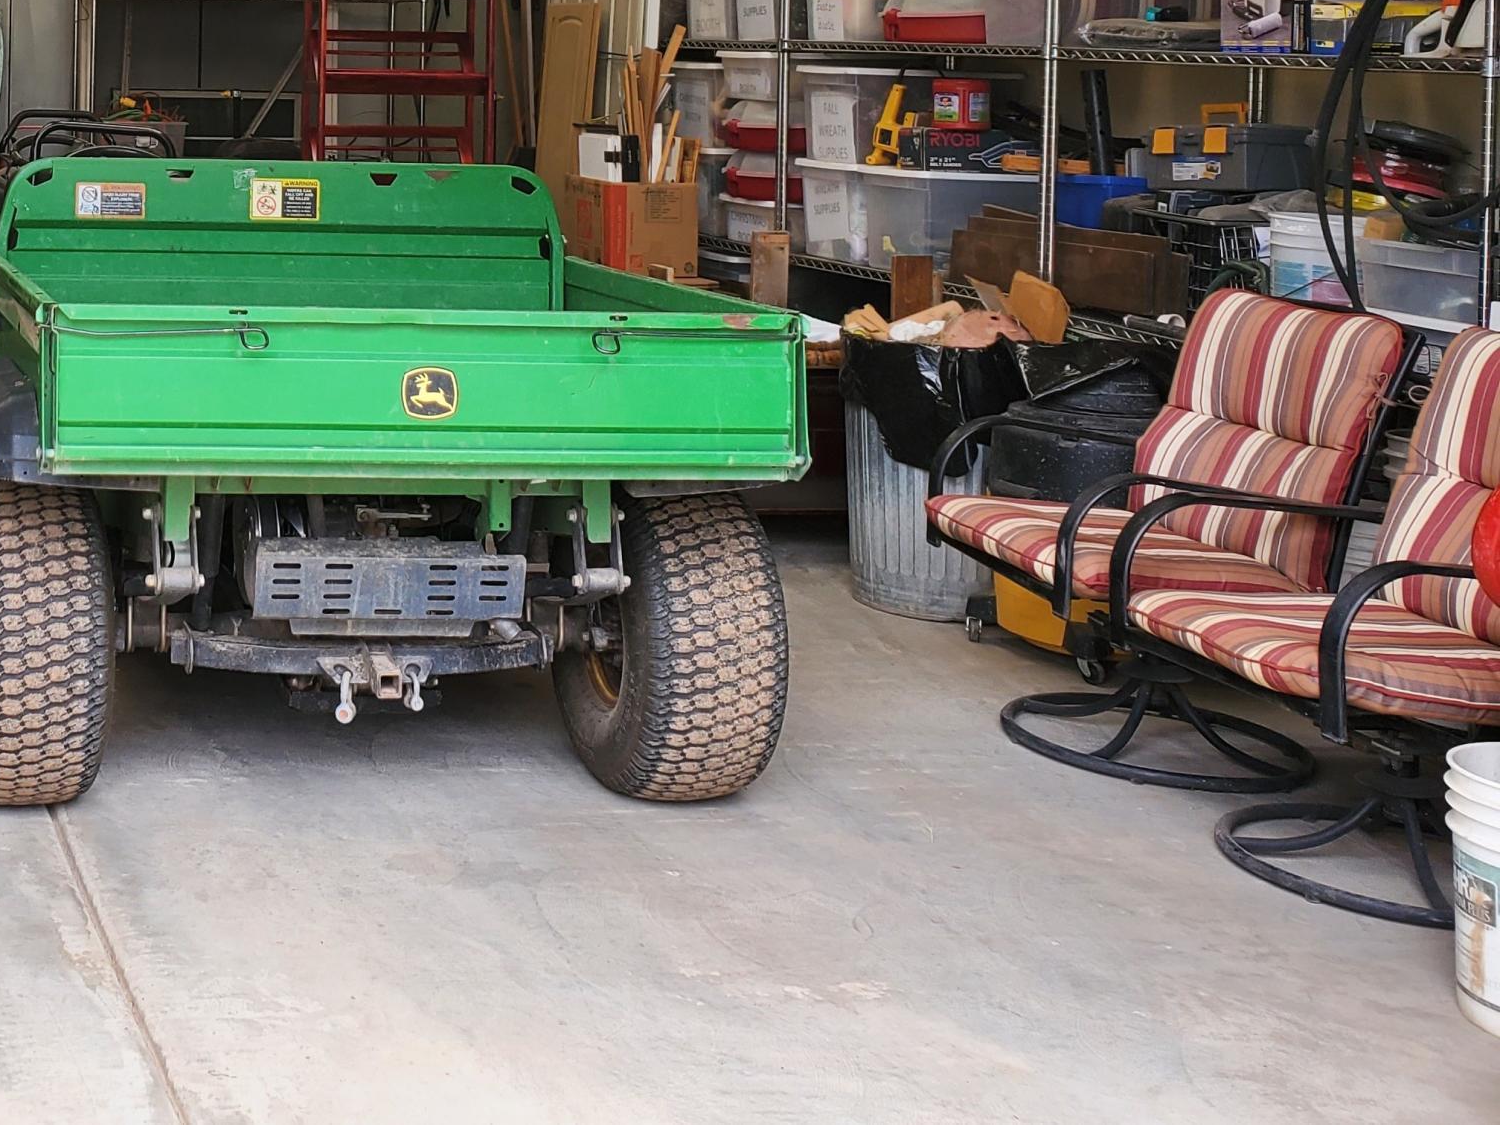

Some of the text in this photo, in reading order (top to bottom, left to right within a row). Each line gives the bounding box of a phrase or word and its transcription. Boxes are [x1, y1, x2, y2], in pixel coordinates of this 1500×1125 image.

[743, 5, 768, 17] SUPPLIES
[823, 101, 840, 115] FALL
[818, 124, 847, 137] WREATH
[929, 131, 981, 148] RYOBI
[818, 146, 848, 160] SUPPLIES
[812, 201, 841, 215] SUPPLIES
